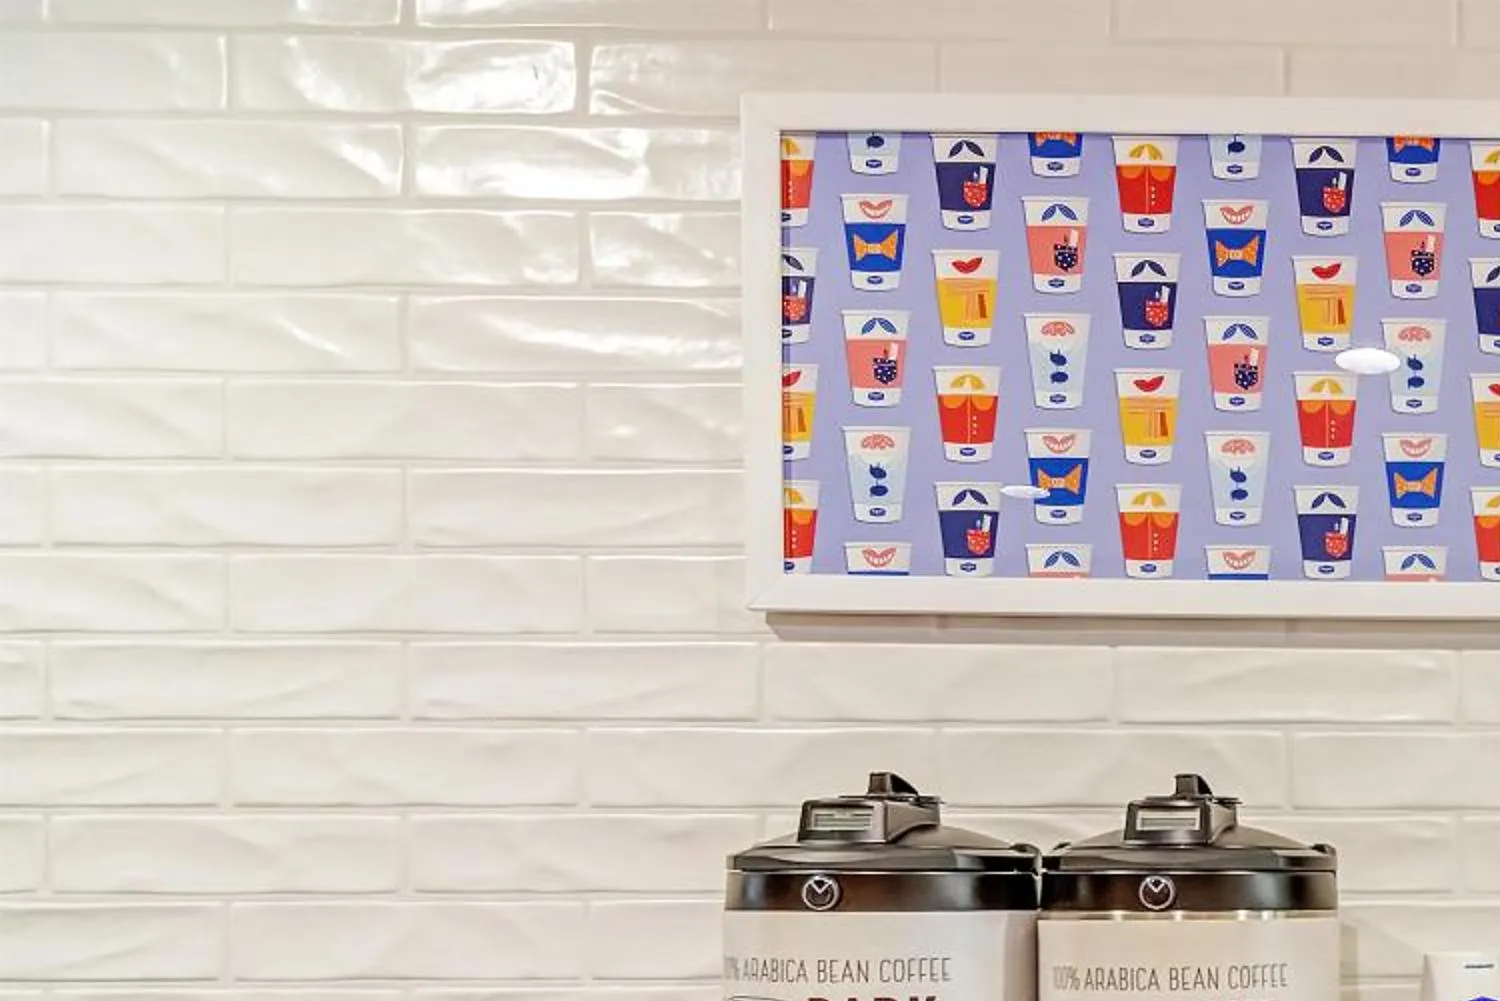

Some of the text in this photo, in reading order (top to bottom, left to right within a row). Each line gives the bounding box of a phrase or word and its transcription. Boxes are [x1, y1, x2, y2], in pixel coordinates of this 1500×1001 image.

[743, 957, 808, 983] ARABICA
[817, 958, 869, 984] BEAN
[879, 957, 952, 983] COFFEE
[1084, 966, 1160, 991] ARABICA
[1169, 966, 1219, 991] BEAN
[1228, 963, 1287, 990] COFFEE
